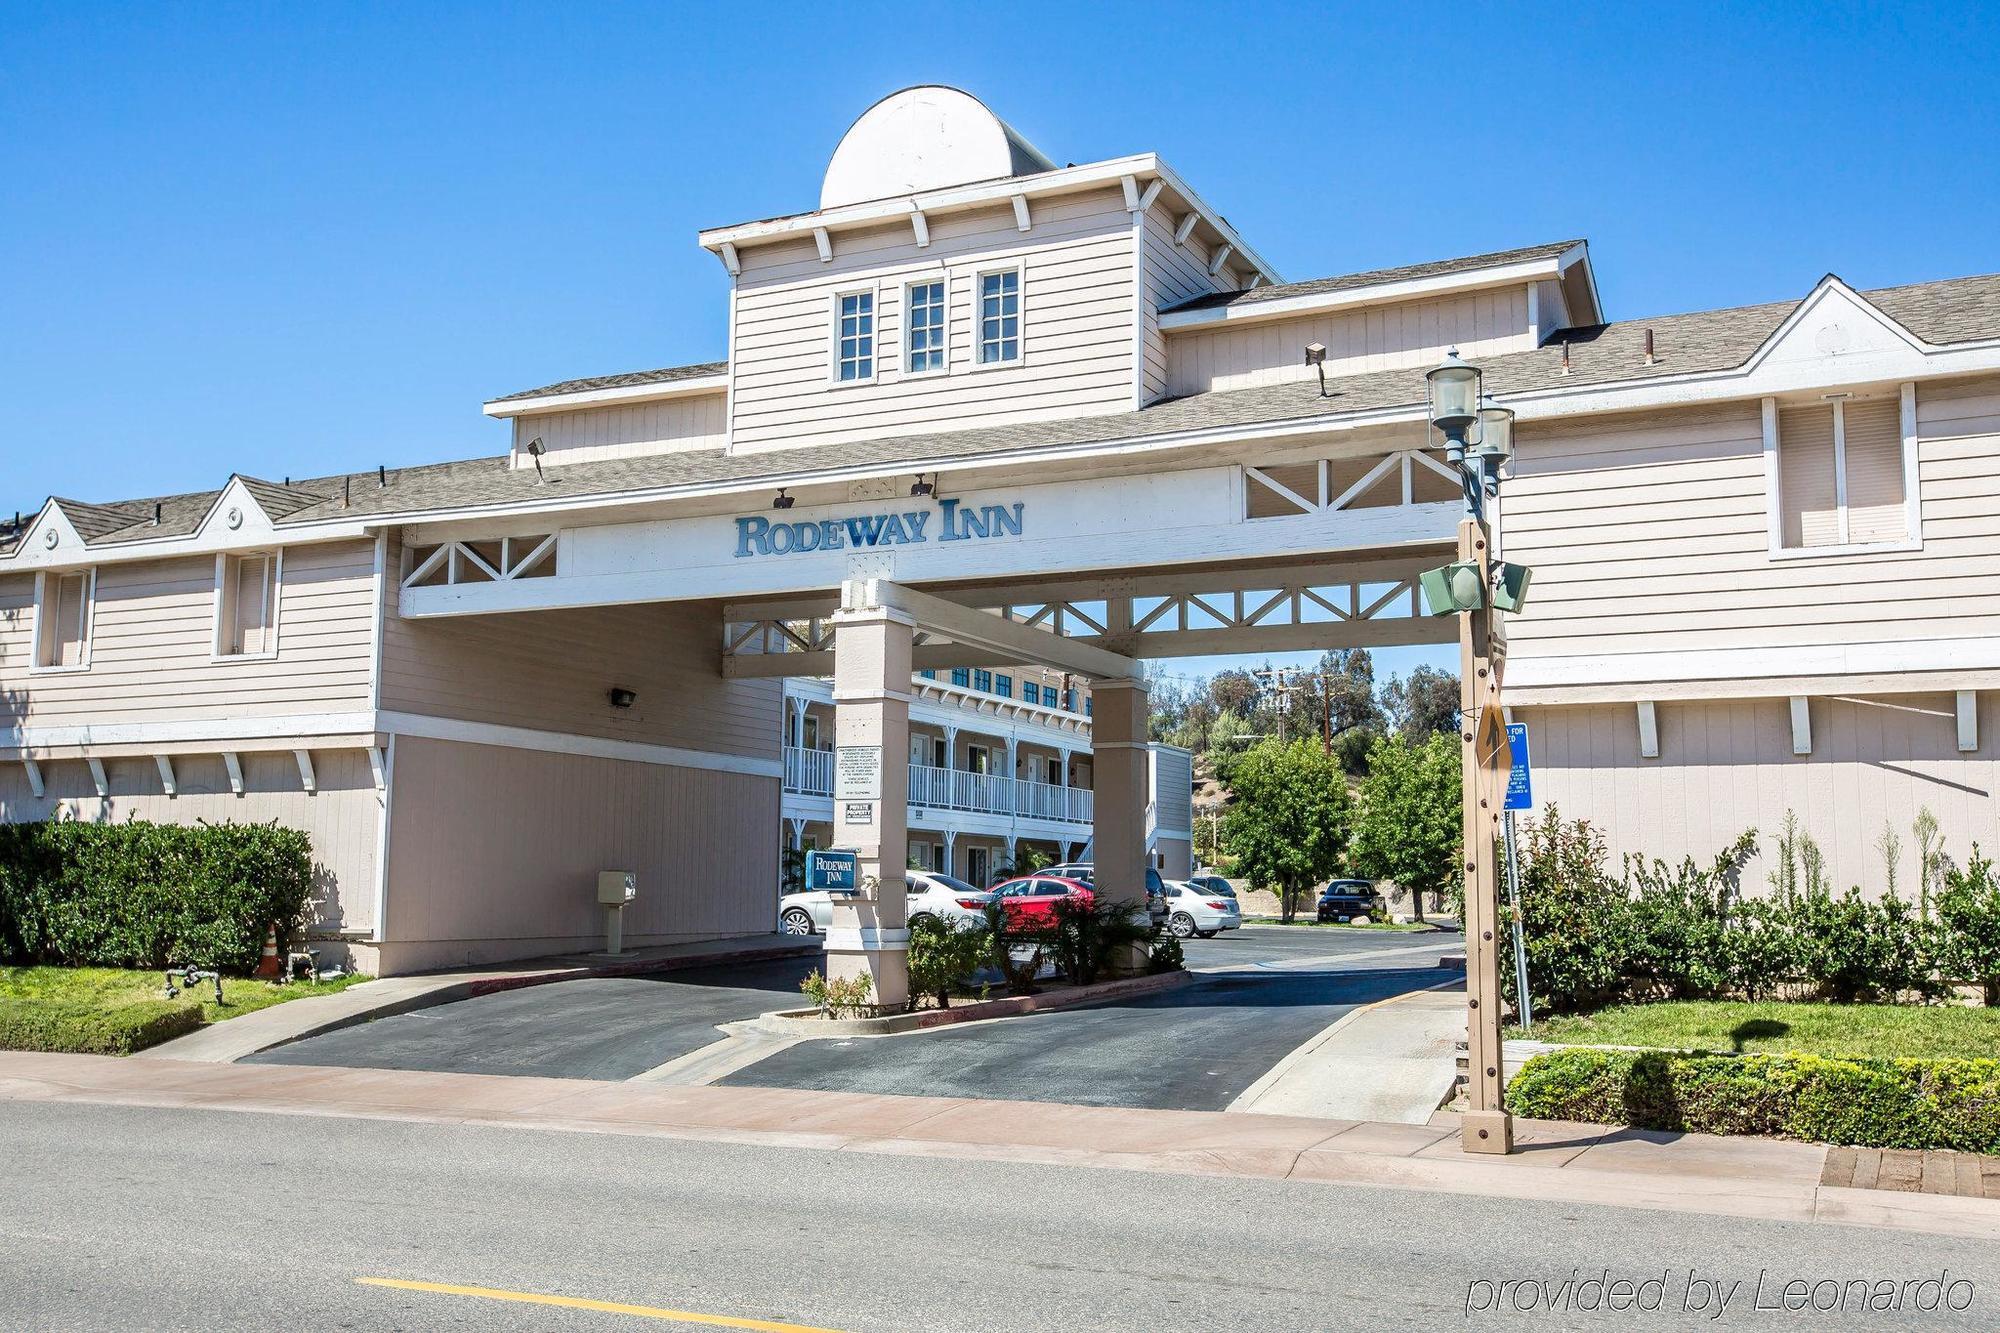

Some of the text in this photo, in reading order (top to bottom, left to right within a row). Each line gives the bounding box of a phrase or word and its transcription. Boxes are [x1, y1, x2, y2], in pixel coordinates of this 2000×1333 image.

[735, 498, 1025, 558] RODEWAY INN
[1511, 727, 1524, 735] FOR
[816, 857, 852, 871] RODEWAY
[826, 871, 842, 885] INN
